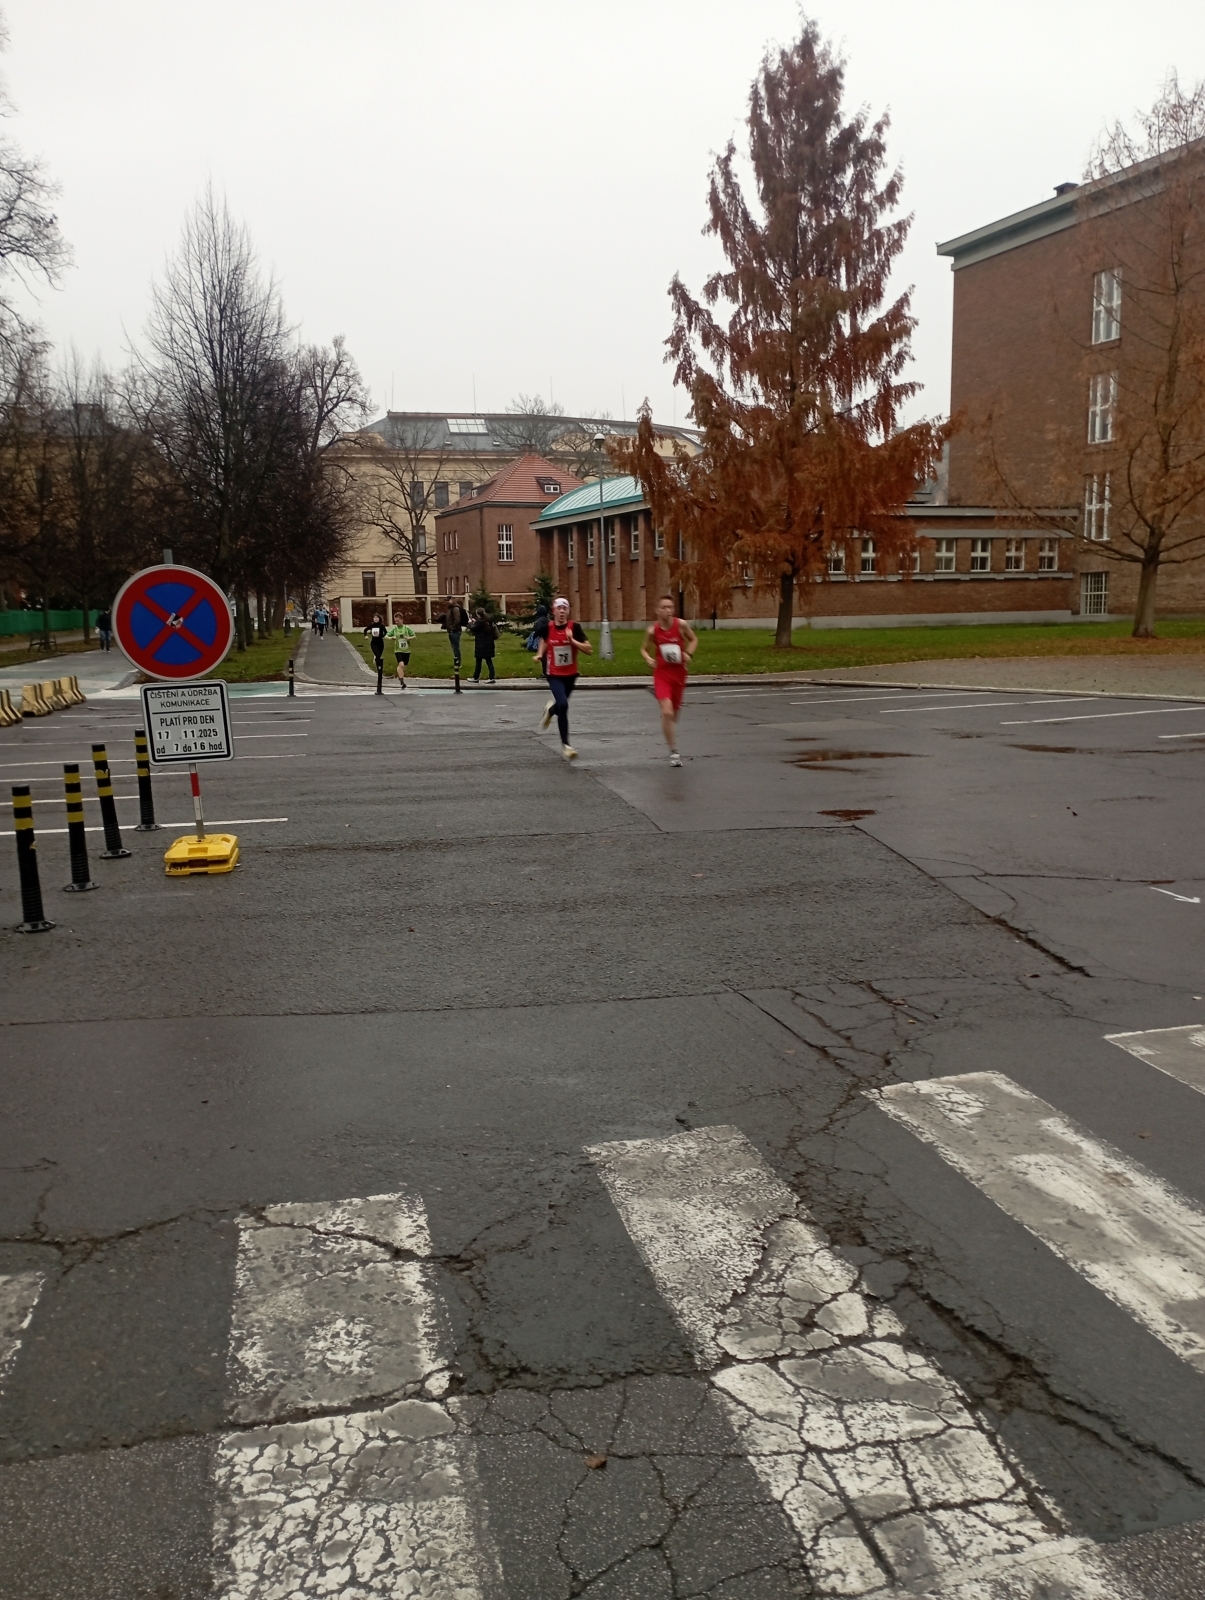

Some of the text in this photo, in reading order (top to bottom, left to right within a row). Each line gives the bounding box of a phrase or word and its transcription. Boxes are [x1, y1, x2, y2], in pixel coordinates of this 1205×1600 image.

[150, 689, 179, 699] ČIŠTĚNÍ
[187, 688, 218, 697] ÚDRŽBA
[160, 698, 210, 708] KOMUNIKACE
[160, 715, 215, 727] PLATÍ PRO DEN
[156, 741, 225, 754] od 7 do 16 hod.
